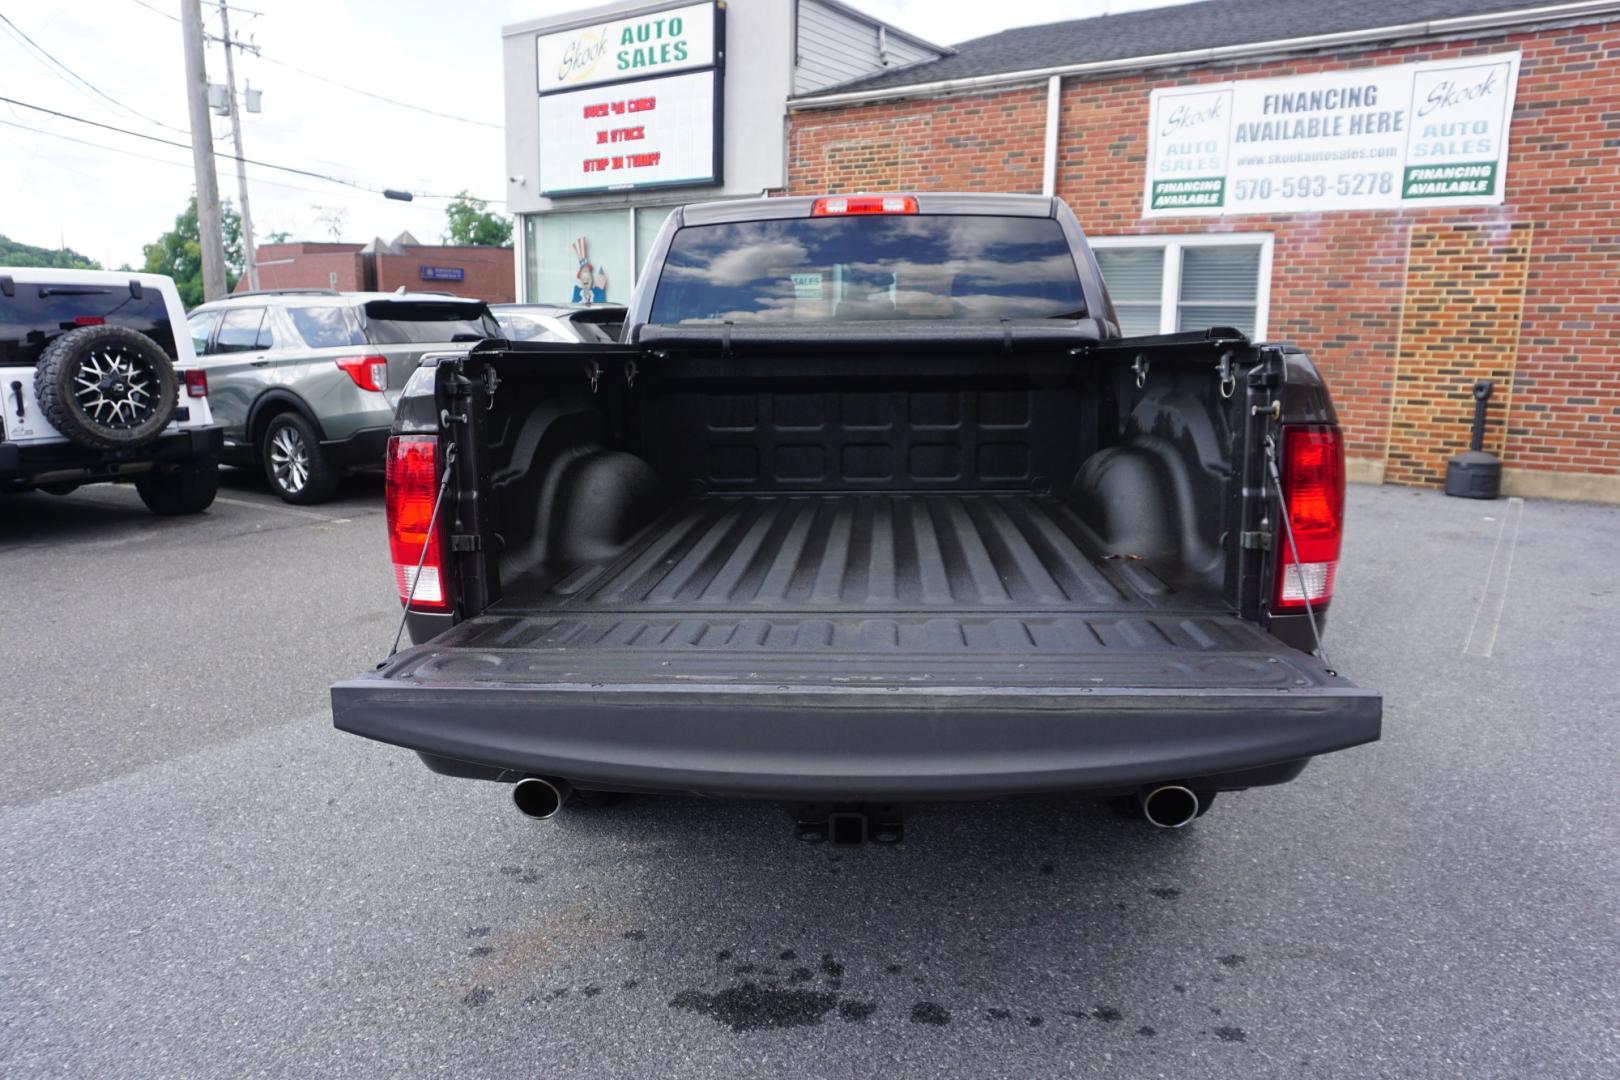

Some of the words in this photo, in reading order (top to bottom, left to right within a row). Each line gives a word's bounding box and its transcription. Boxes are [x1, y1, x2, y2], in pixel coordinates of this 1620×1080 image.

[620, 17, 683, 46] AUTO
[617, 41, 688, 70] SALES
[1263, 85, 1378, 115] FINANCING
[1417, 69, 1496, 117] Skook
[1161, 96, 1222, 137] Skook
[1235, 116, 1344, 143] AVAILABLE
[1349, 110, 1405, 135] HERE
[1423, 120, 1489, 138] AUTO
[1167, 141, 1218, 156] AUTO
[1236, 147, 1398, 166] www.skookautosales.com
[1414, 139, 1492, 157] SALES
[1160, 157, 1220, 172] SALES
[1409, 166, 1492, 181] FINANCING
[1156, 180, 1222, 193] FINANCING
[1235, 171, 1394, 201] 570-593-5278
[1406, 180, 1489, 195] AVAILABLE
[1154, 193, 1219, 206] AVAILABLE
